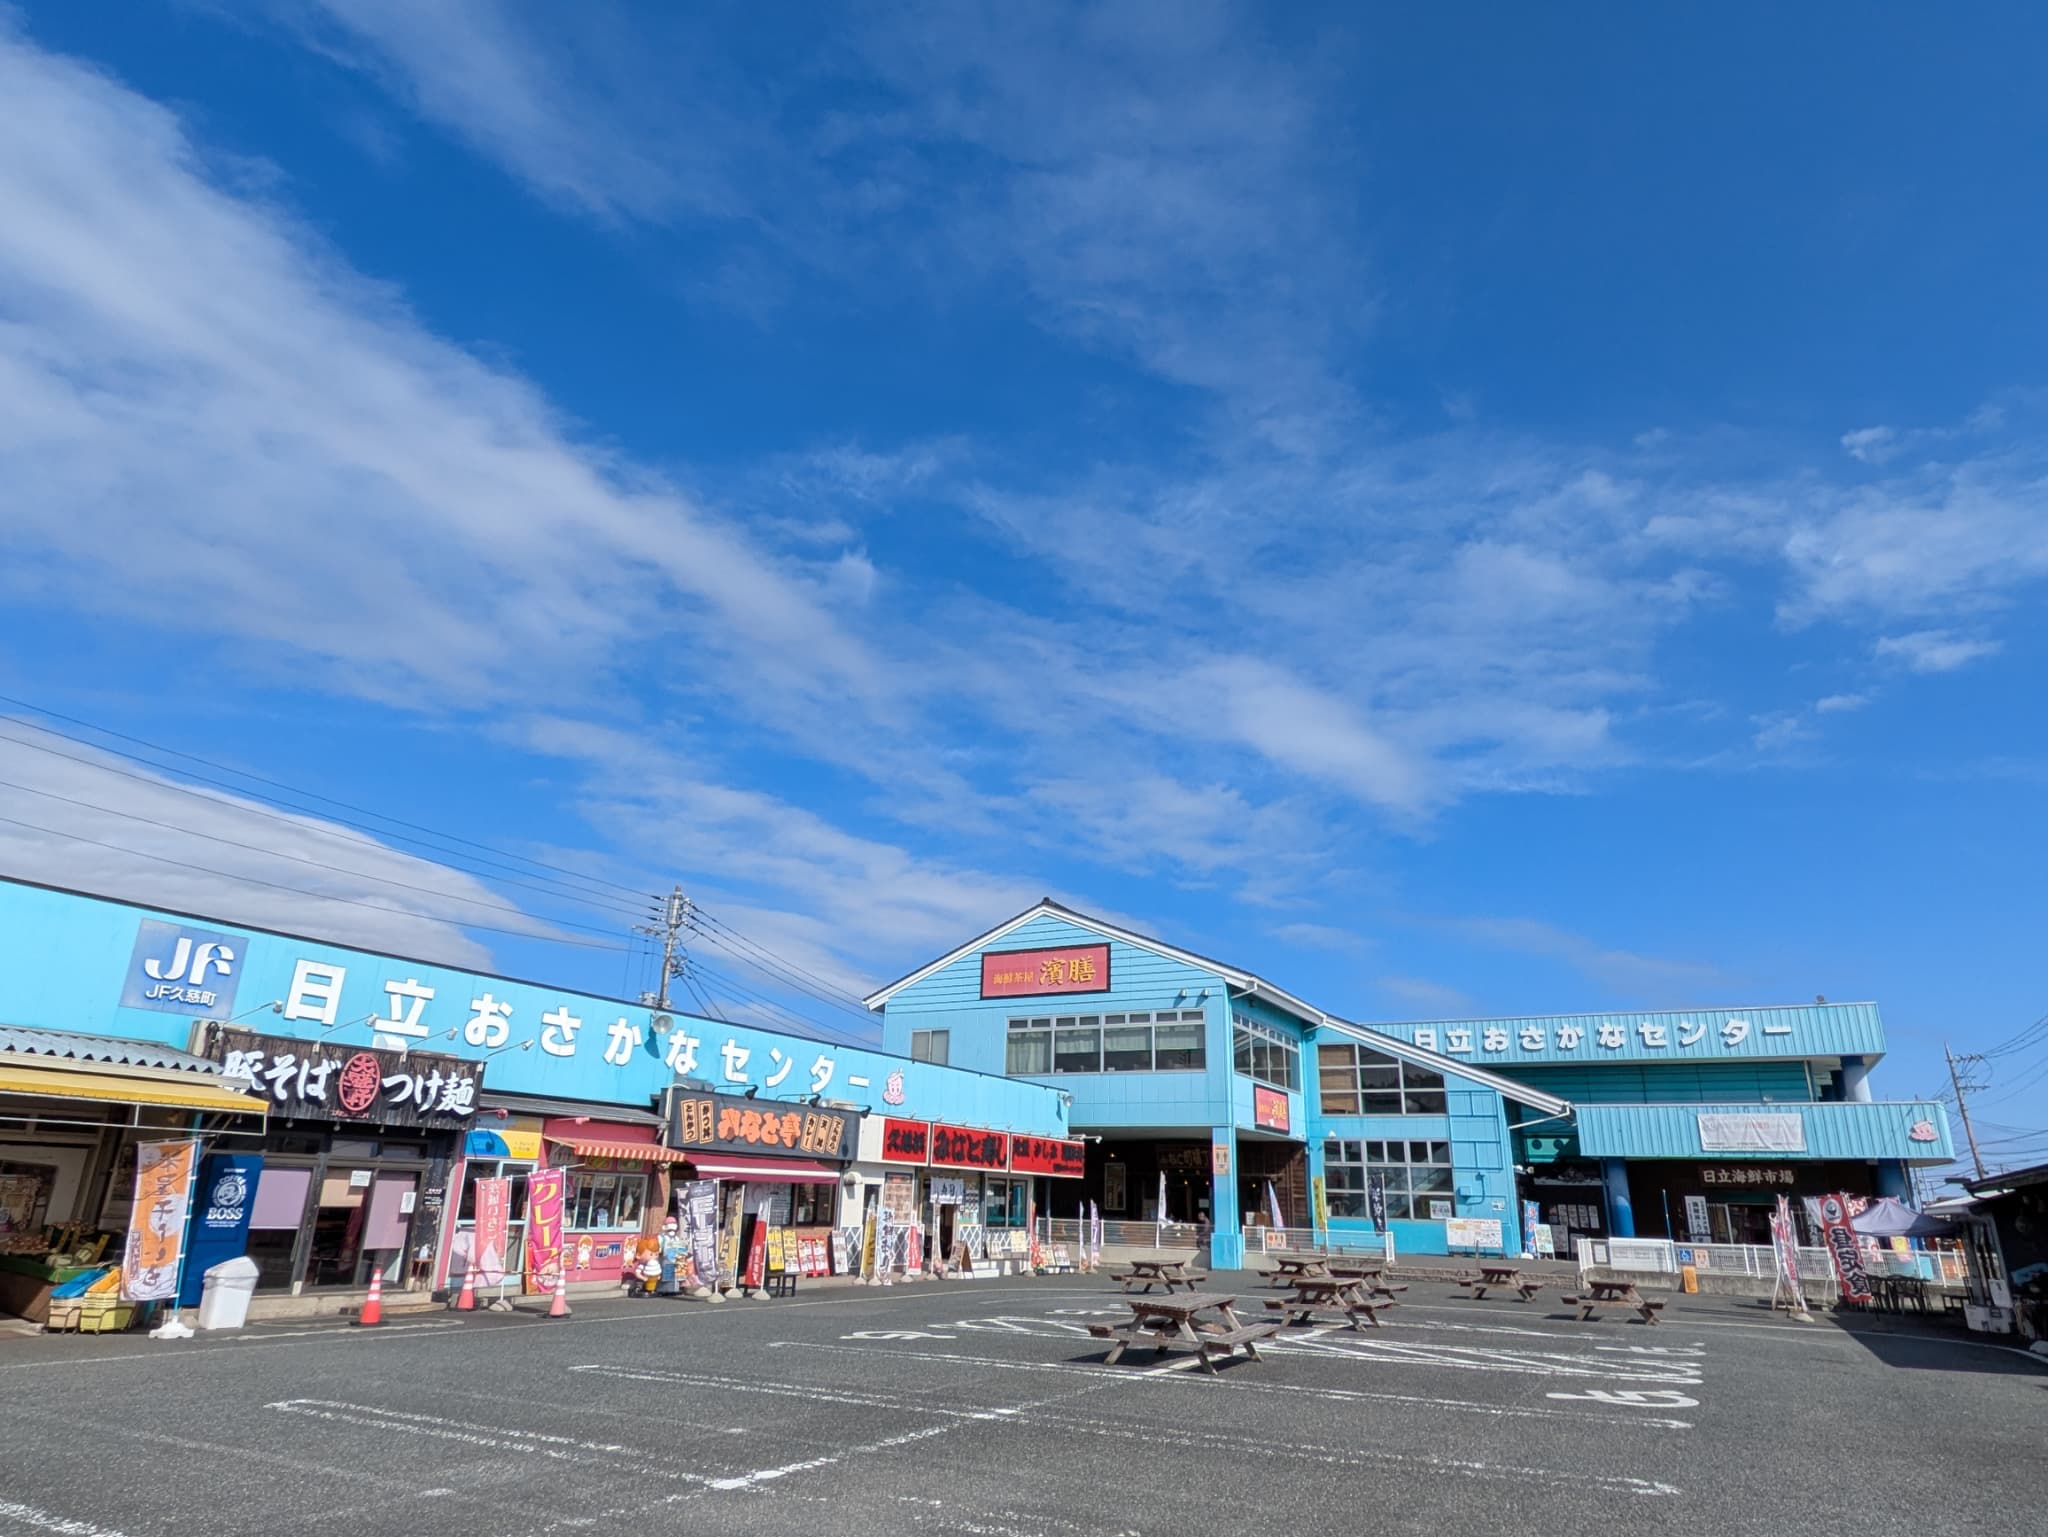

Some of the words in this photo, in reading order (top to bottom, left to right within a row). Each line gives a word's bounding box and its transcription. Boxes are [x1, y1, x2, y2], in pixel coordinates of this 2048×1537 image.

[145, 984, 217, 1008] JF久慈町
[284, 958, 870, 1093] 日立おさかなセンター
[1415, 1019, 1793, 1053] 日立おさかなセンター
[382, 1068, 475, 1116] つけ麺
[1703, 1169, 1795, 1184] 日立海鮮市場
[206, 1206, 244, 1220] BOSS
